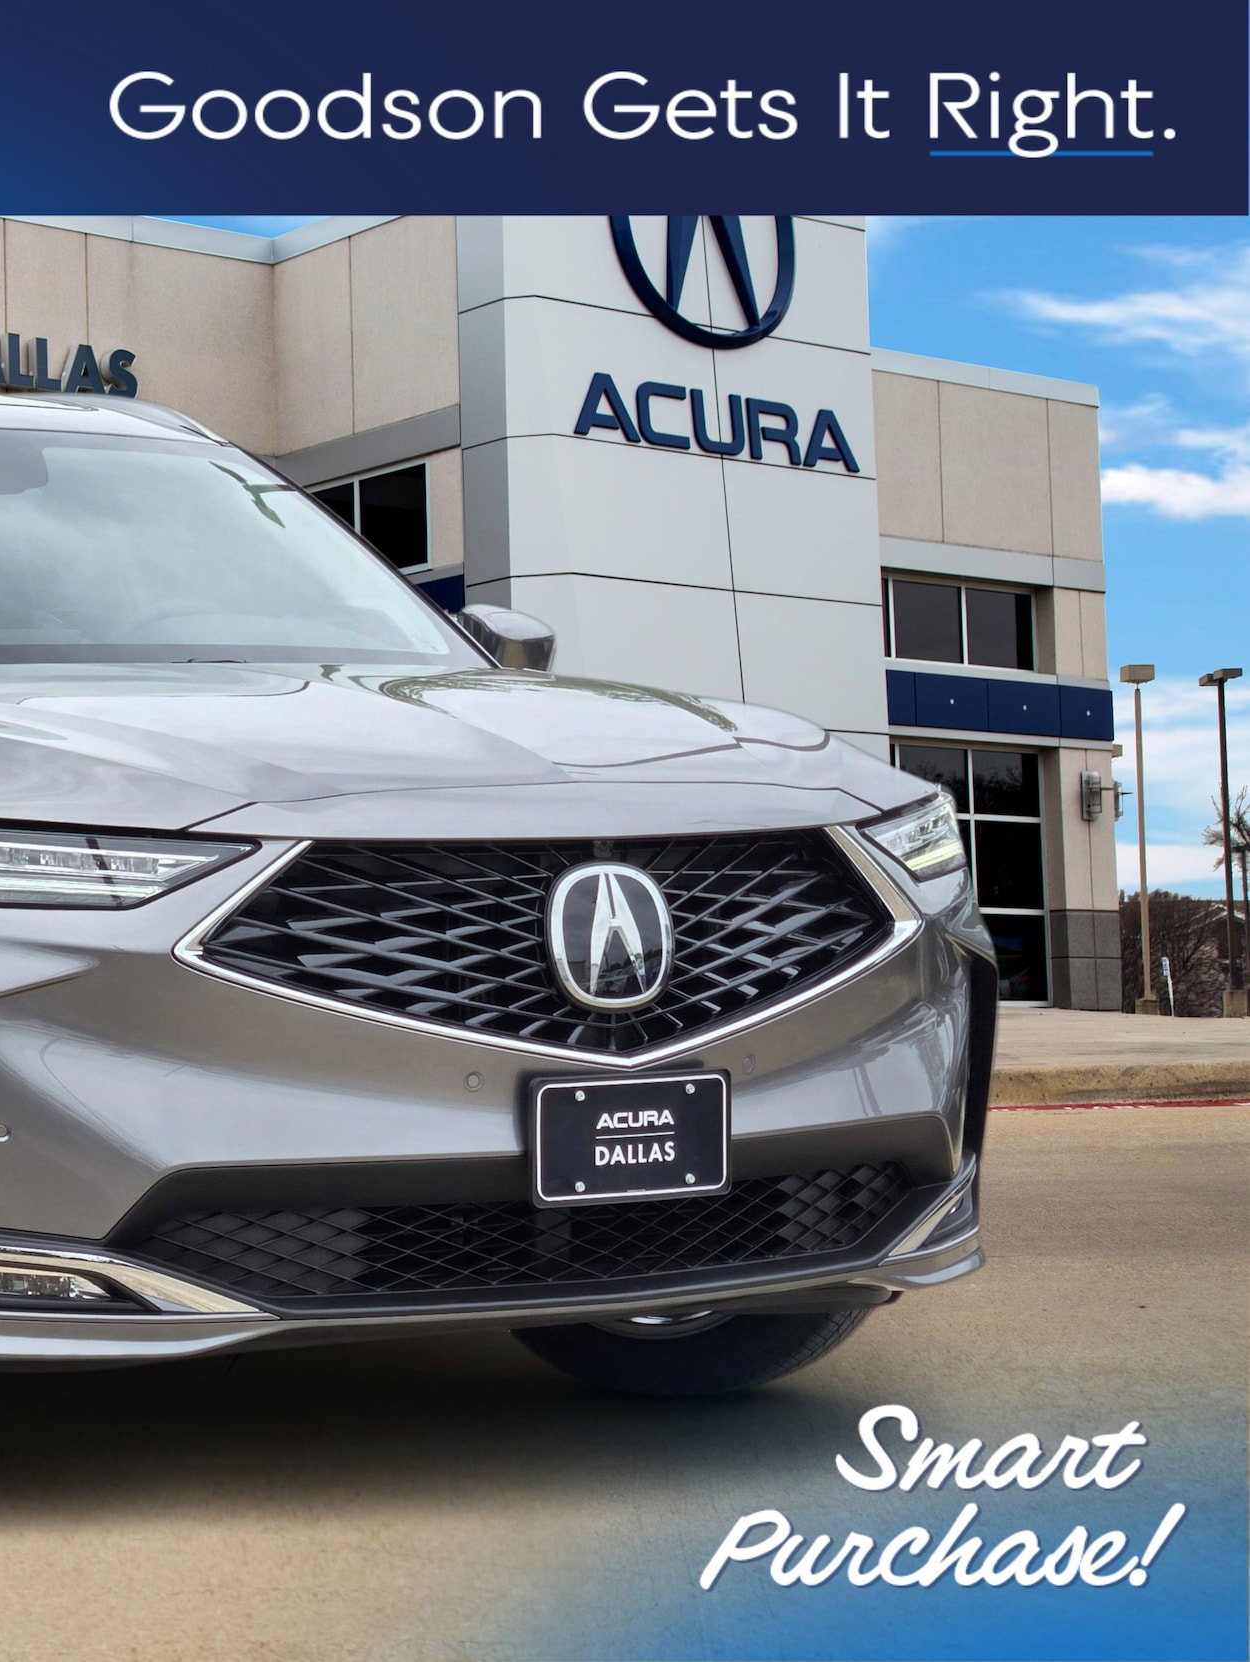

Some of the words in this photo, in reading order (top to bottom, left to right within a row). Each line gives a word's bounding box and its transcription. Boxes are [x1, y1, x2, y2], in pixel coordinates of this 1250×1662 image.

[574, 372, 861, 473] ACURA
[595, 1109, 675, 1130] ACURA
[594, 1141, 676, 1166] DALLAS
